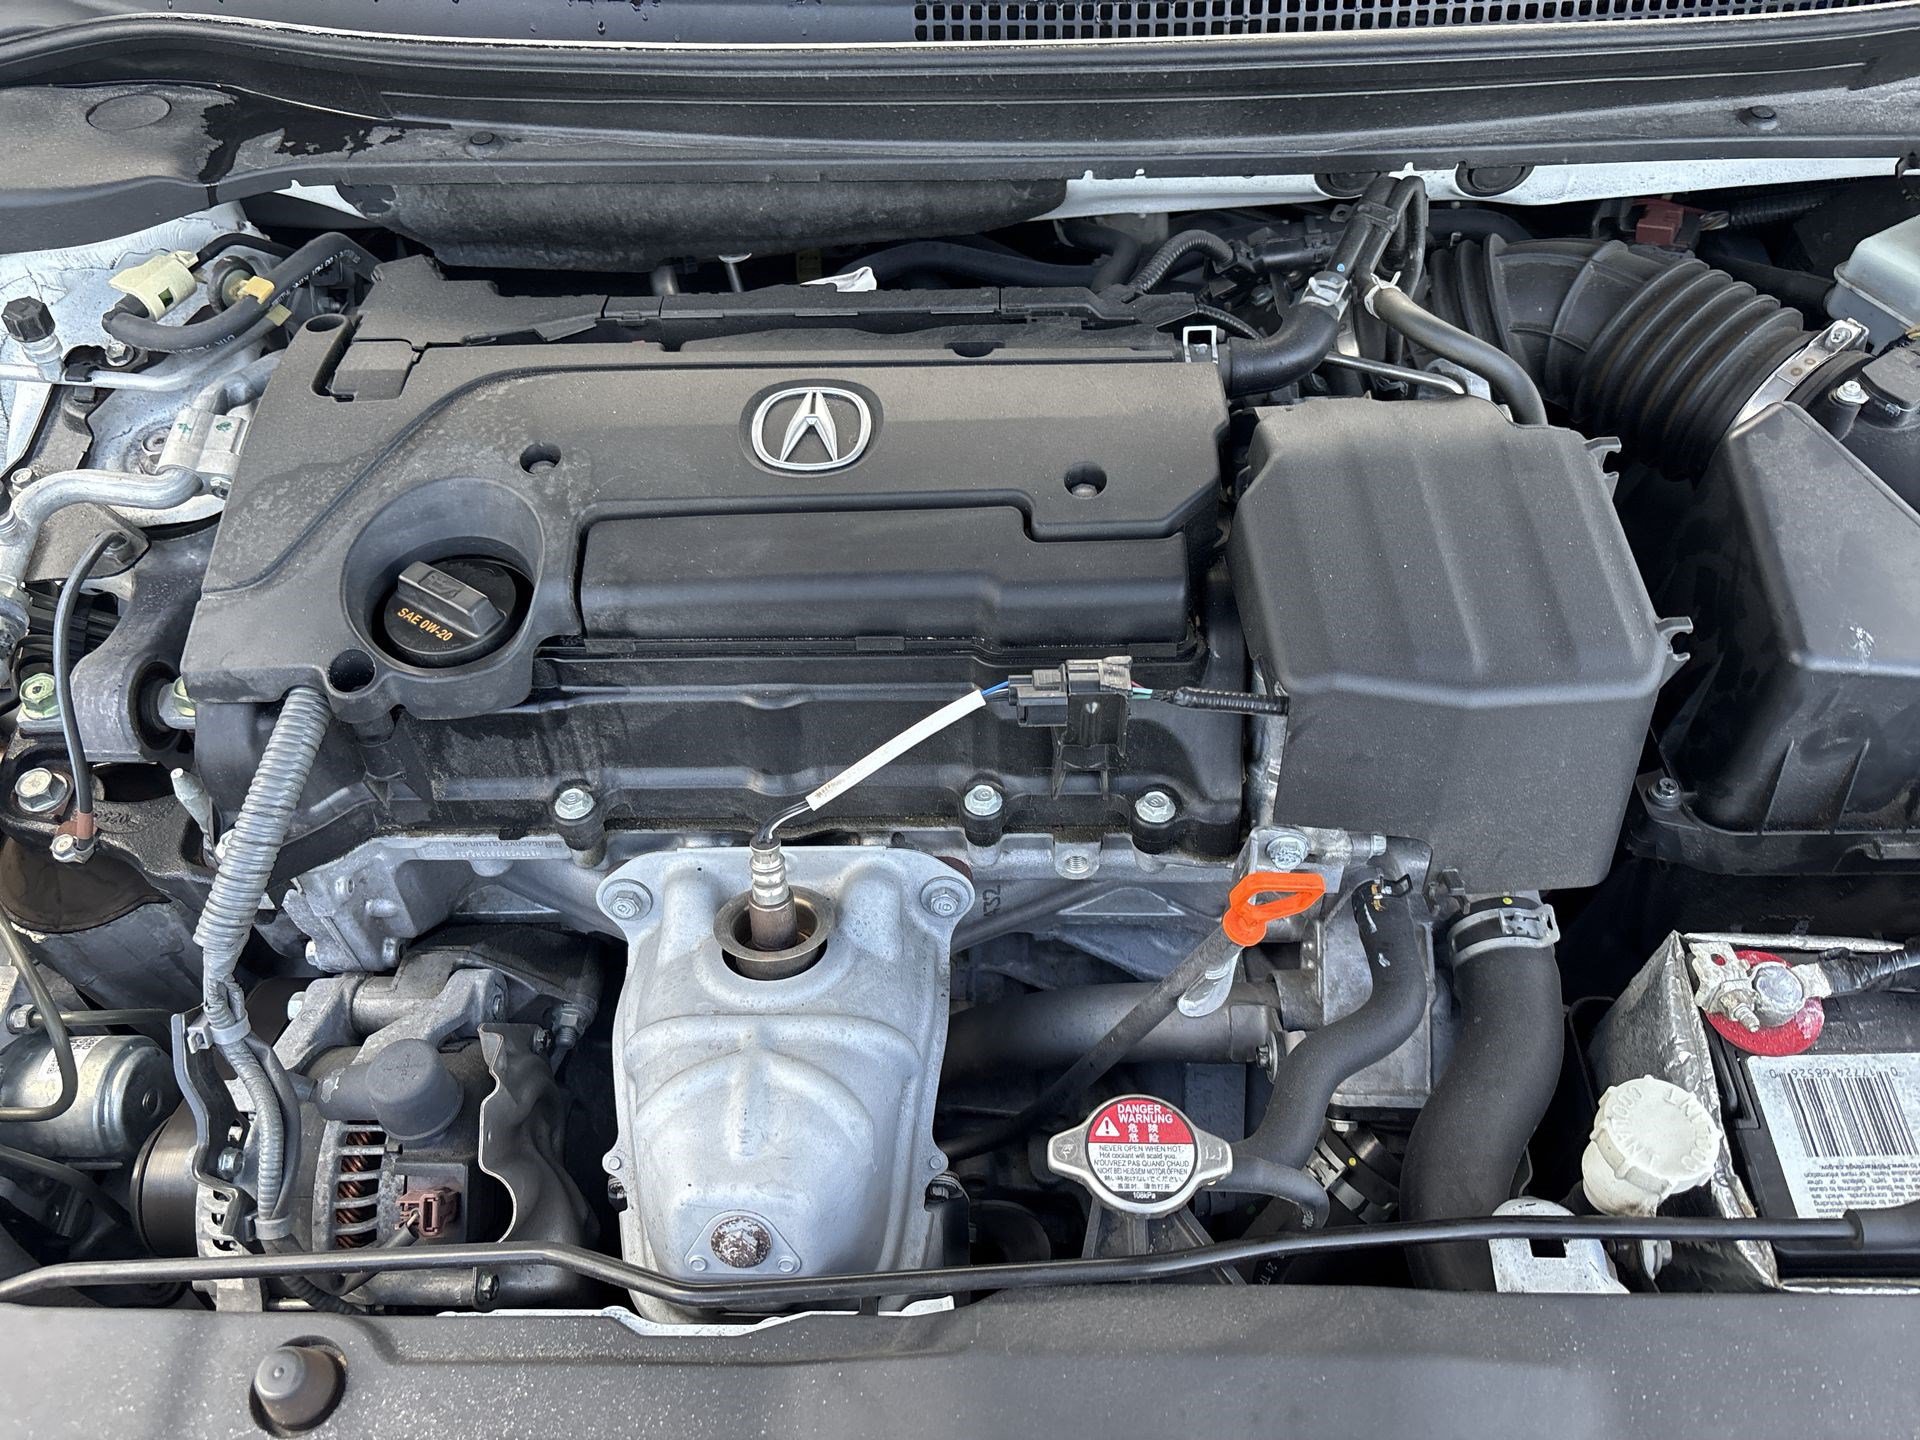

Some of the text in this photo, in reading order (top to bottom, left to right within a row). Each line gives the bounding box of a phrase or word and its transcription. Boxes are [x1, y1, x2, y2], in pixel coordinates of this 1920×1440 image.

[397, 607, 455, 642] SAE 0W-20
[1790, 1068, 1831, 1078] 68526
[1117, 1103, 1162, 1114] DANGER
[1118, 1113, 1174, 1124] WARNUNG
[1132, 1192, 1157, 1200] 108kPa
